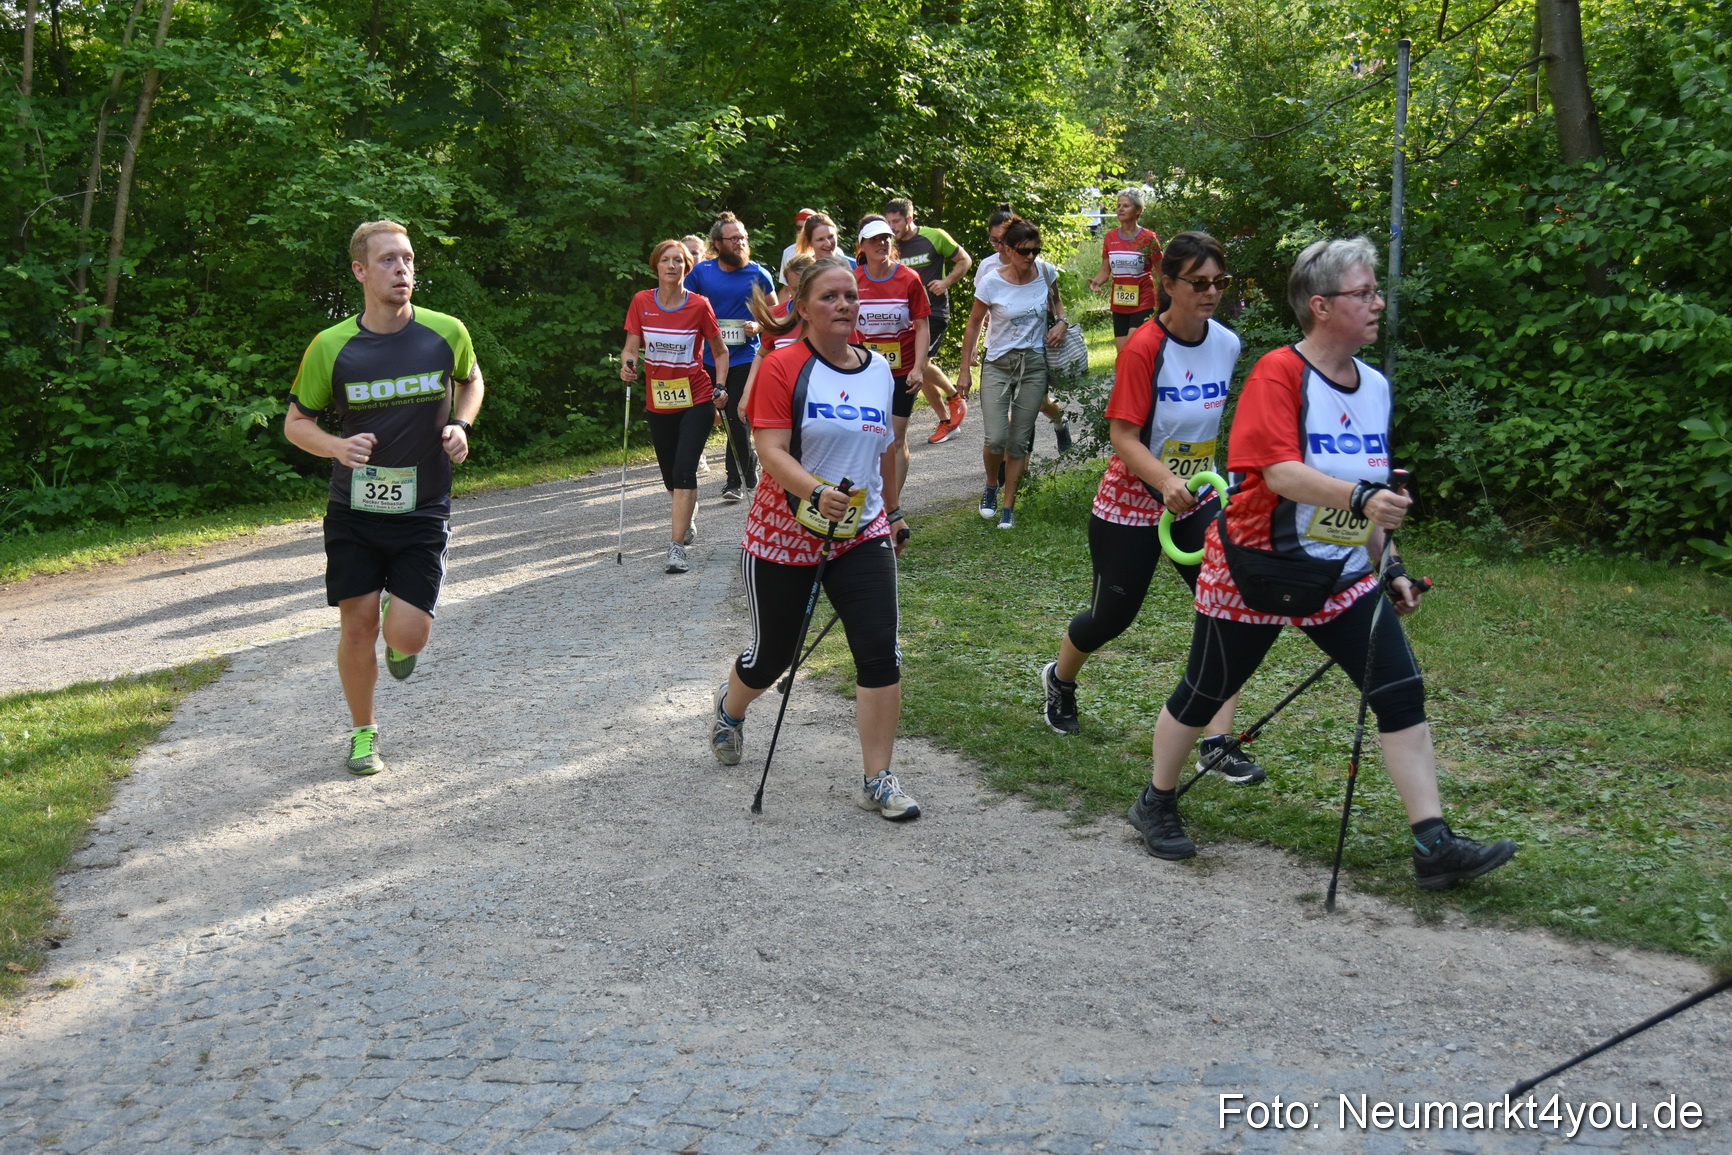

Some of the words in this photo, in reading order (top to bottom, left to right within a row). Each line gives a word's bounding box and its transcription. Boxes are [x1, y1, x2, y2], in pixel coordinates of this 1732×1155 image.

[1116, 292, 1135, 300] 1826
[866, 313, 901, 322] Petry
[655, 342, 687, 351] Petry
[883, 353, 896, 362] 19
[346, 372, 443, 402] BOCK
[656, 388, 687, 401] 1814
[348, 402, 377, 411] inspired
[379, 401, 389, 409] by
[391, 398, 414, 406] smart
[1168, 456, 1209, 476] 2073
[365, 482, 402, 501] 325
